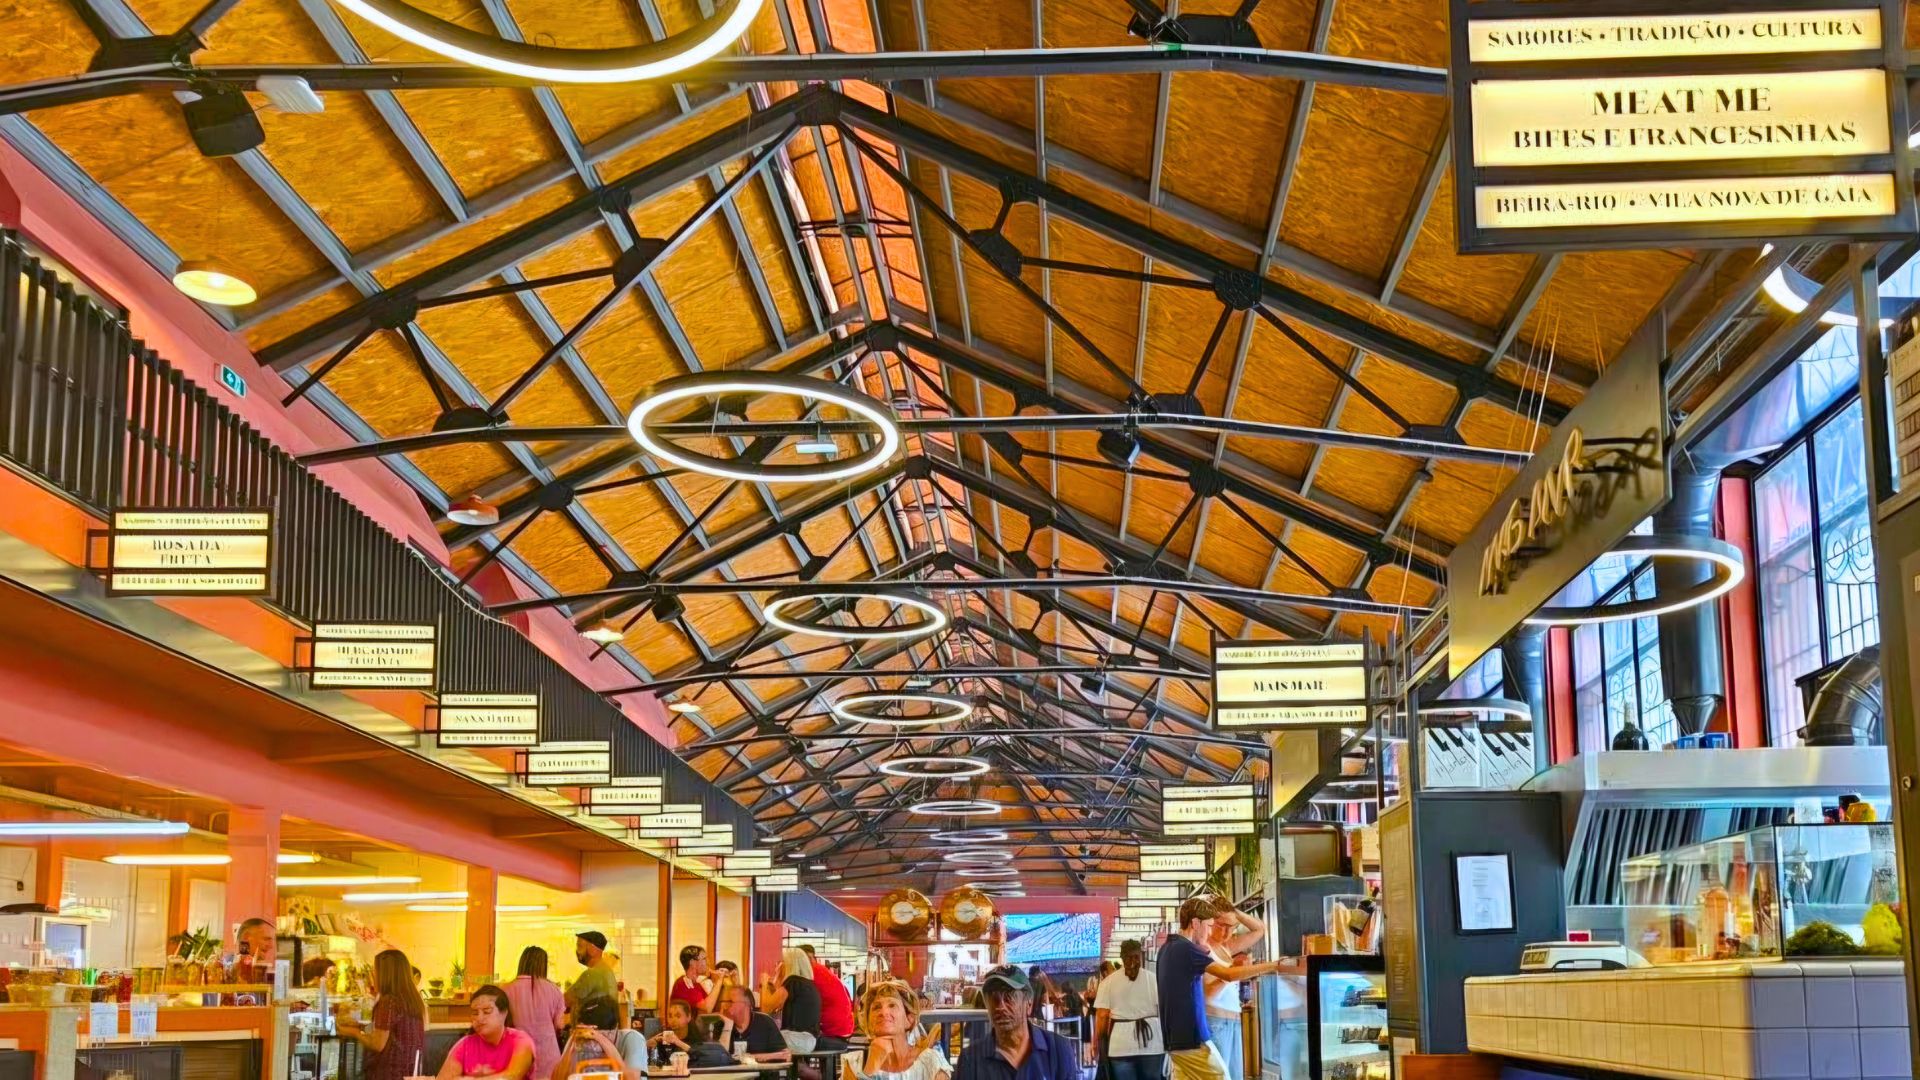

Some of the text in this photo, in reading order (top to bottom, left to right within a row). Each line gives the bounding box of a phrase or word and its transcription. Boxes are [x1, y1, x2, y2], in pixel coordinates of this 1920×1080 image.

[1487, 20, 1864, 48] SABORES TRADIÇÃO CULTURA
[1593, 87, 1772, 116] MEAT ME
[1513, 121, 1857, 149] BIFES E FRANCESINHAS
[1495, 194, 1617, 214] BEIRA-RIO
[1648, 191, 1706, 209] VILA
[1709, 190, 1772, 208] NOVA
[1815, 187, 1873, 204] GAIA
